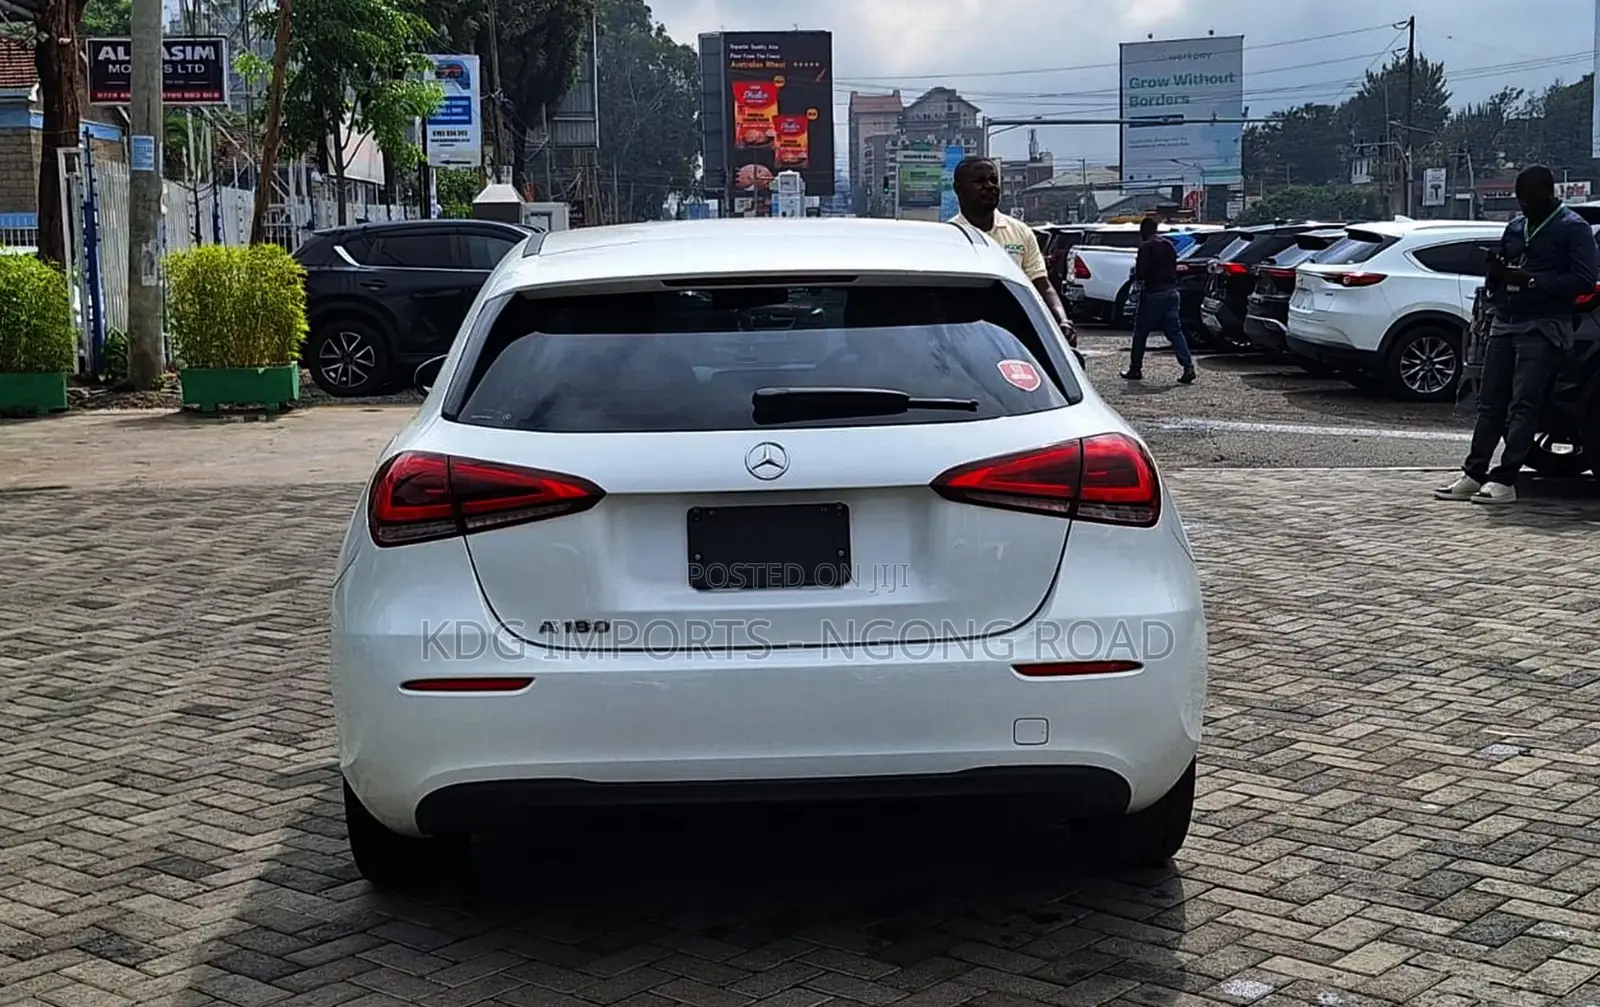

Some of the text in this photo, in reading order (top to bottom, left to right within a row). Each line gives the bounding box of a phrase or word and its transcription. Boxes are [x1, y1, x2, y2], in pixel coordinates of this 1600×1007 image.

[98, 45, 131, 60] AL
[177, 64, 205, 73] LTD
[1129, 72, 1236, 89] Grow Without
[1129, 94, 1190, 107] Borders
[539, 620, 611, 634] A 180
